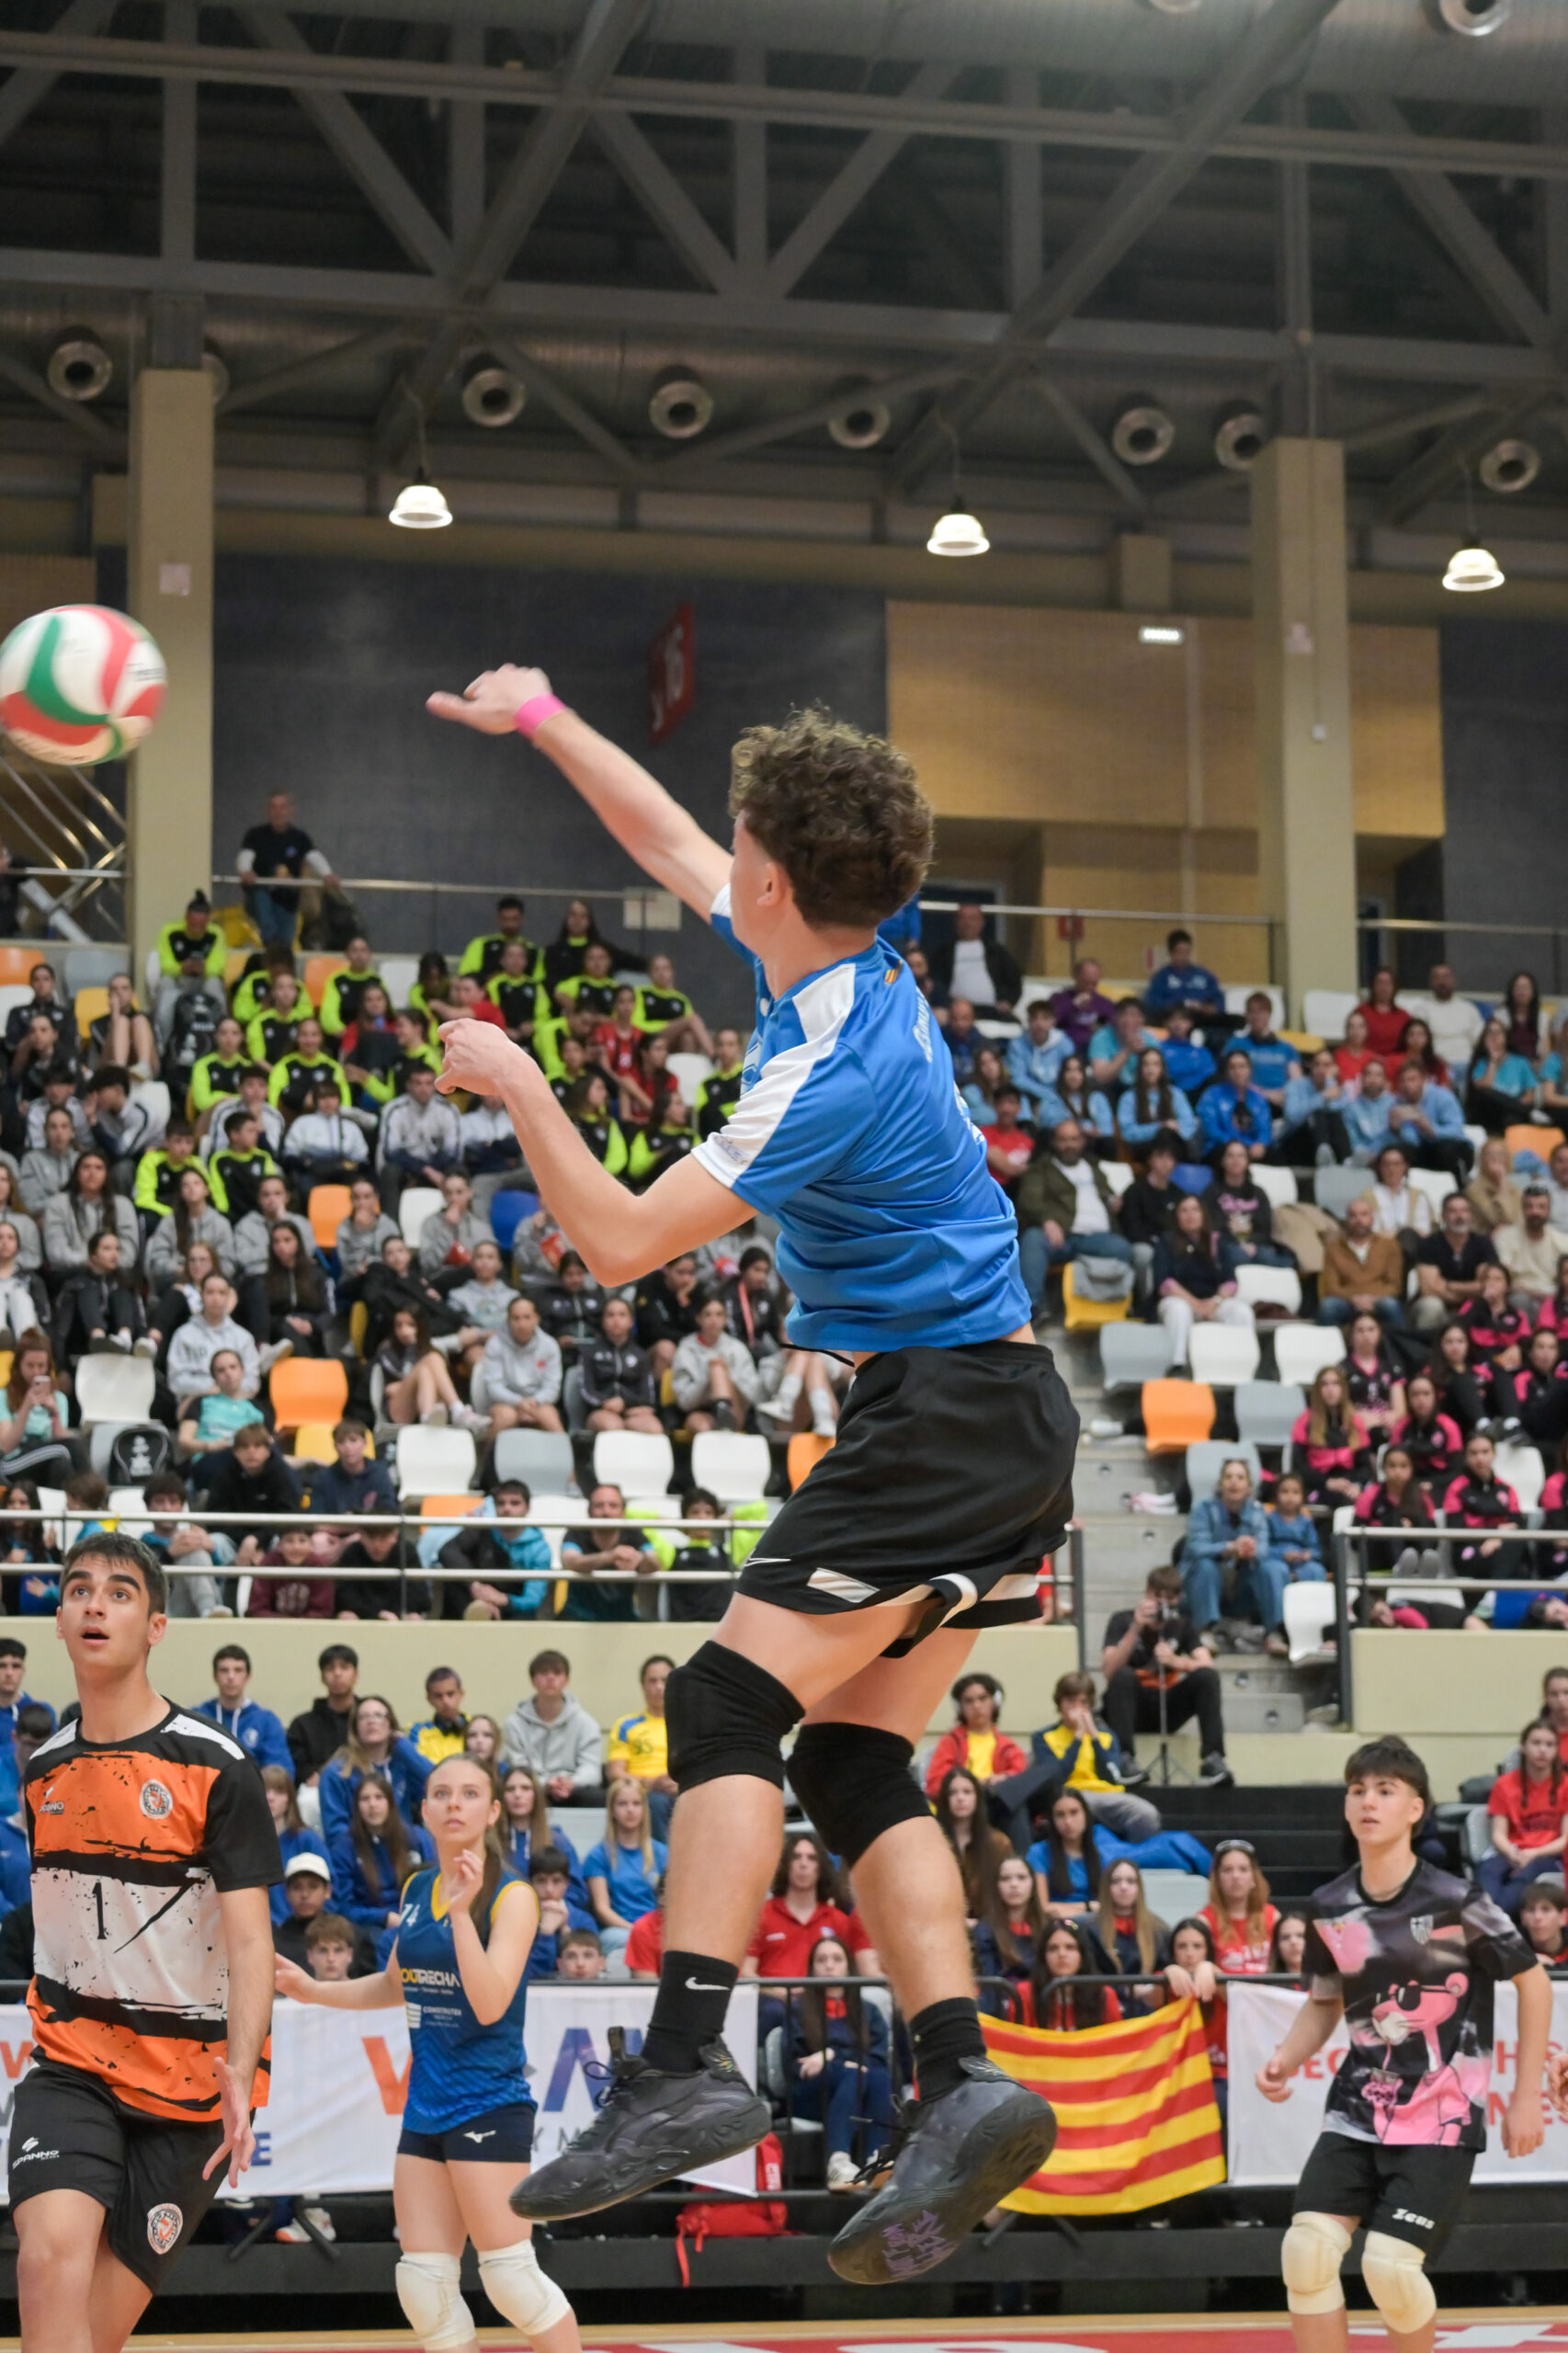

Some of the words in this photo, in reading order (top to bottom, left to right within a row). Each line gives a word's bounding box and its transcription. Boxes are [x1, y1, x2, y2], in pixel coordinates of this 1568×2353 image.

[92, 1881, 107, 1939] 1
[399, 1903, 421, 1927] 14
[12, 2150, 60, 2169] SPANNO
